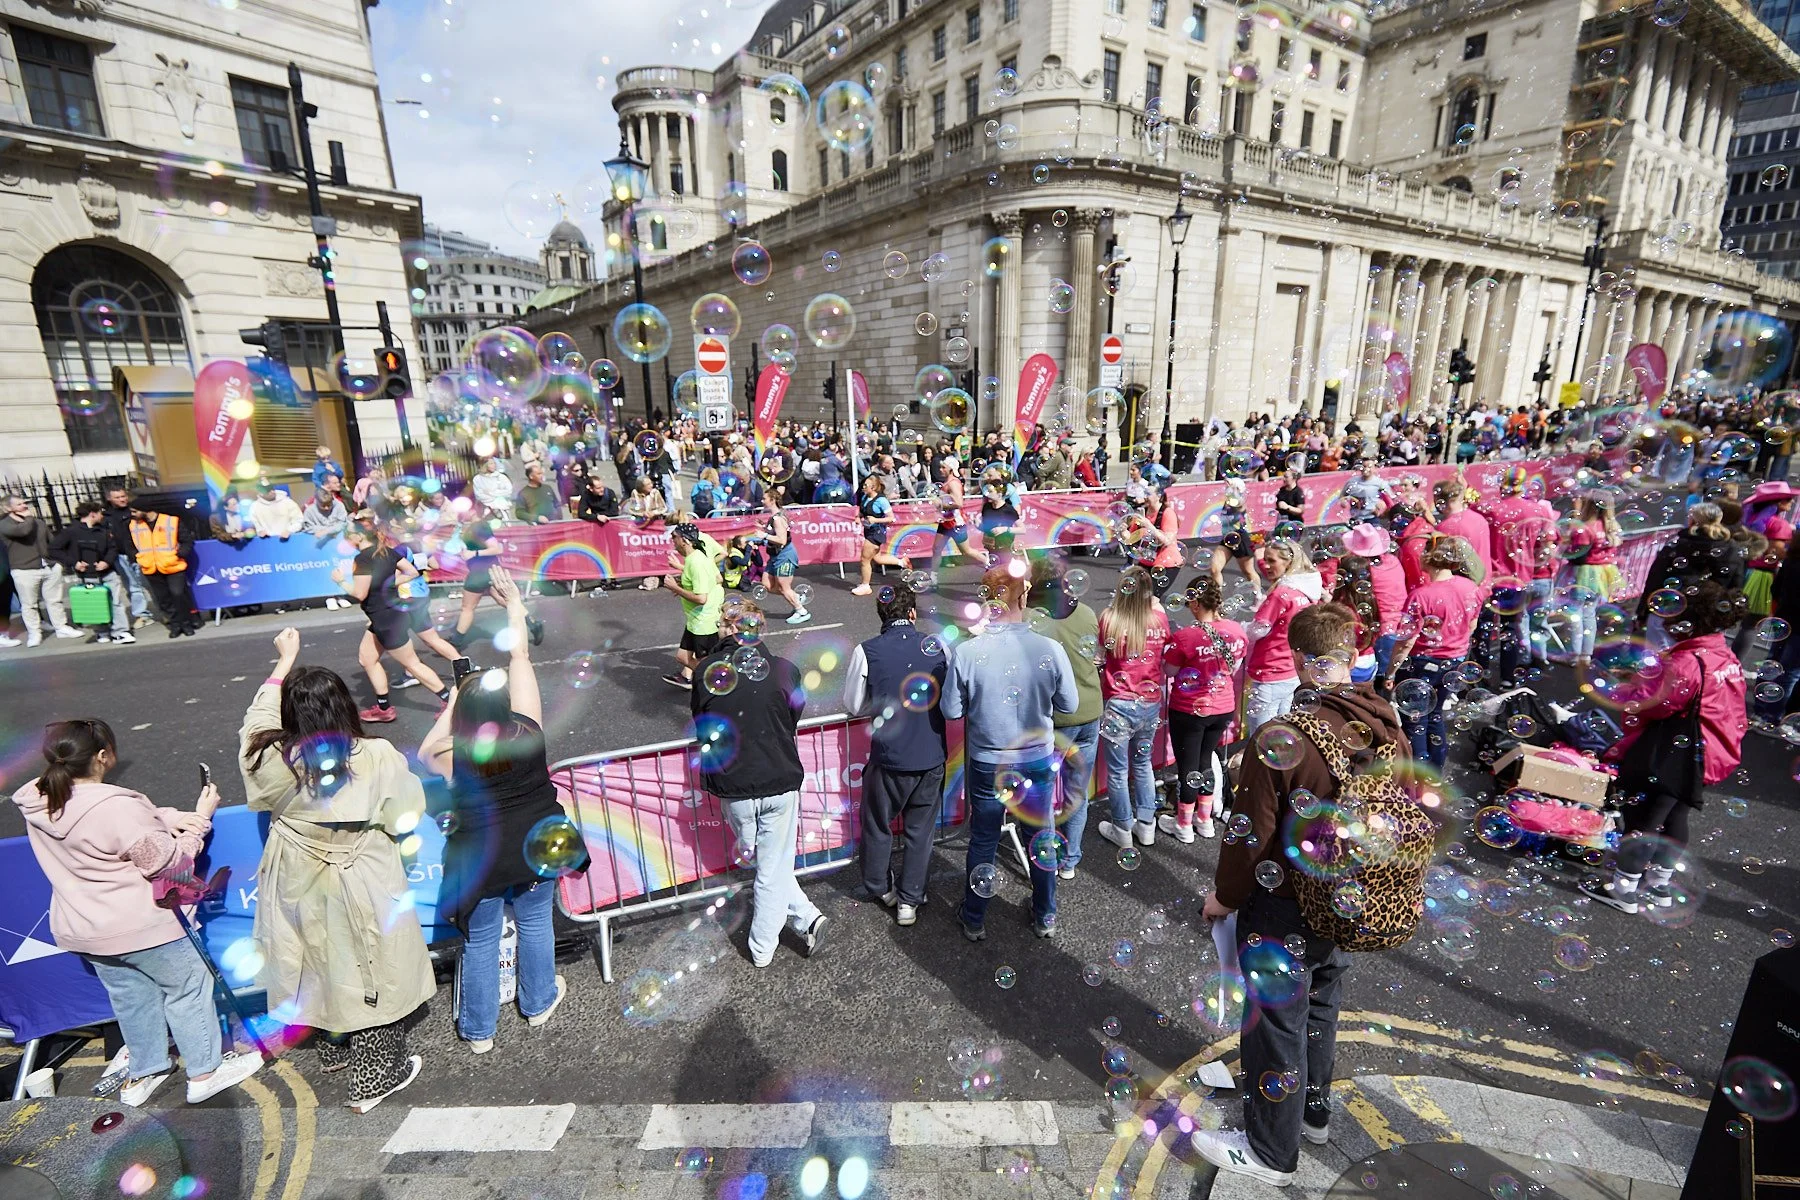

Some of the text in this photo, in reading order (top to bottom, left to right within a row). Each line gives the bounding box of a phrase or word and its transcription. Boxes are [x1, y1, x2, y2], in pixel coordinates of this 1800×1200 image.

[759, 374, 781, 419] Tommy's
[1021, 366, 1047, 416] Tommy's
[798, 520, 862, 535] Tommy
[220, 563, 272, 578] MOORE
[275, 559, 330, 573] Kingston
